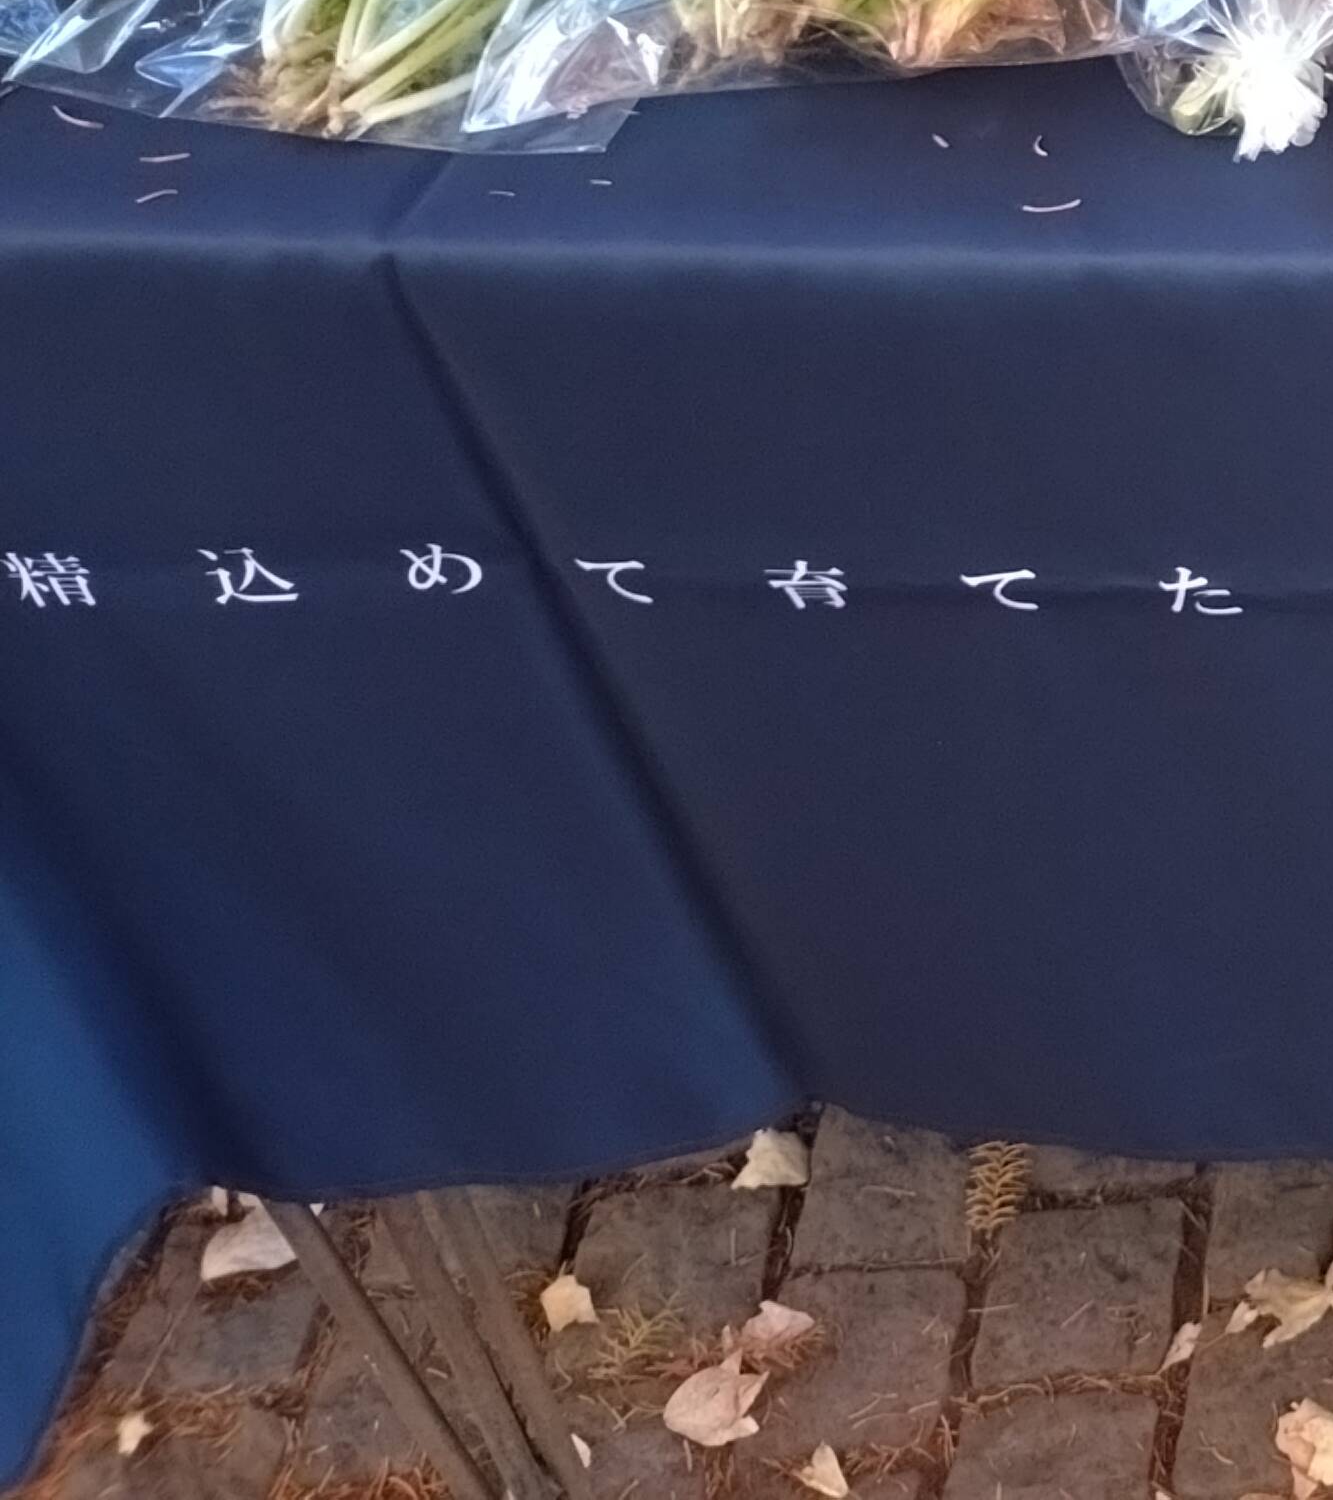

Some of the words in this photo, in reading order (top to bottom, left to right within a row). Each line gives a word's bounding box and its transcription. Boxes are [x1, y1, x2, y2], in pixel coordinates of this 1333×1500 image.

[0, 543, 1243, 615] 精込めて育てた
